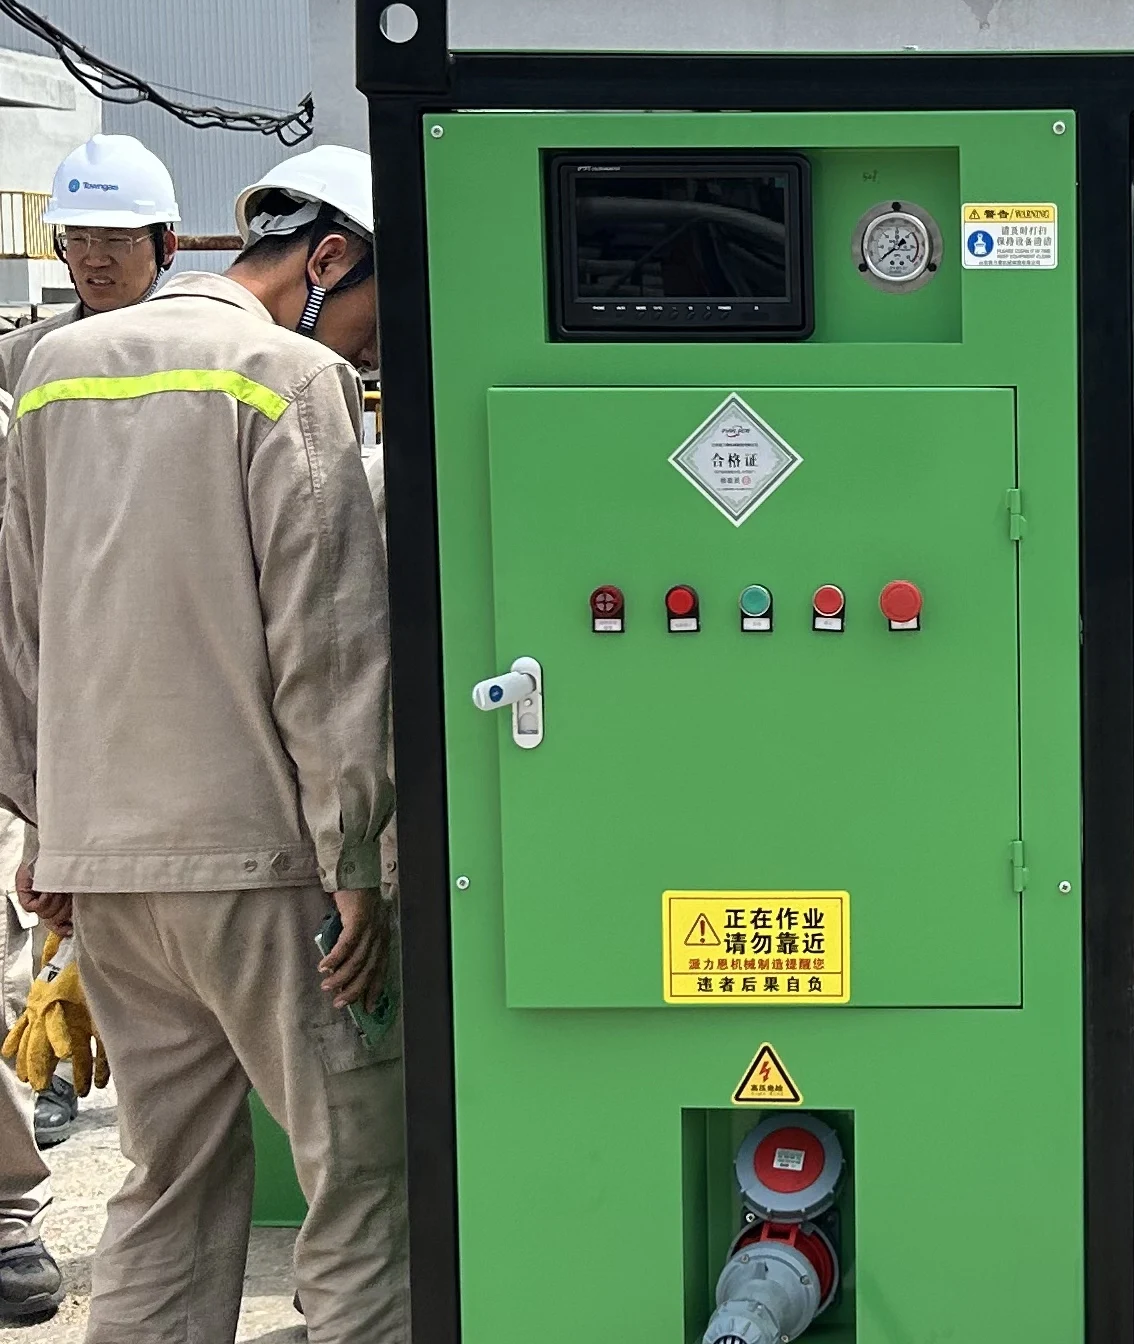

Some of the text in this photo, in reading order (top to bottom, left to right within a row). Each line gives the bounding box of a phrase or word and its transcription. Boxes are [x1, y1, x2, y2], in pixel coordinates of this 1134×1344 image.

[83, 182, 119, 191] Towngas
[711, 452, 758, 468] 合格证
[724, 908, 825, 930] 正在作业
[724, 932, 825, 954] 请勿靠近
[697, 976, 822, 992] 违者后果自负
